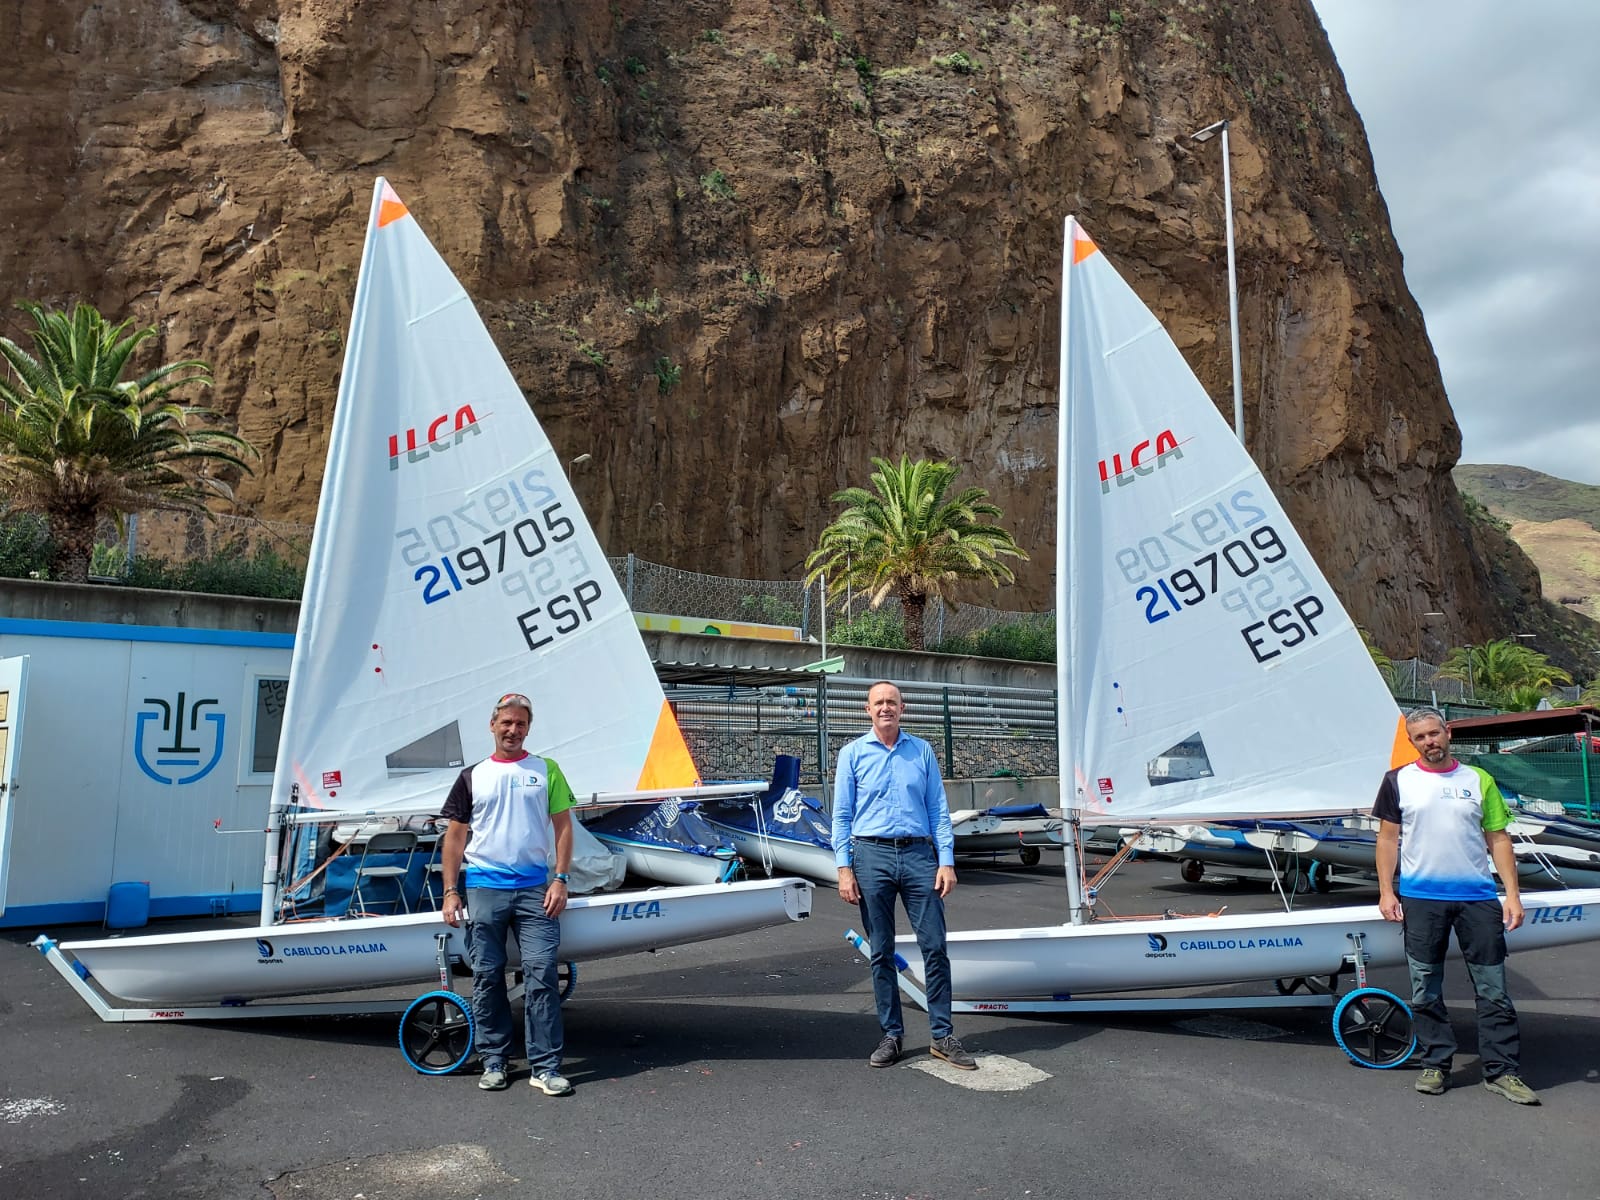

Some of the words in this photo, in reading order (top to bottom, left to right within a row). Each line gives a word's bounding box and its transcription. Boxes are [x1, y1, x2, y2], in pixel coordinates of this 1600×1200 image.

[389, 404, 482, 470] ILCA
[1098, 430, 1184, 494] ILCA
[414, 503, 575, 604] 219705
[1136, 525, 1287, 623] 219709
[517, 580, 601, 651] ESP
[1241, 595, 1324, 663] ESP
[611, 900, 661, 921] ILCA
[1531, 905, 1583, 924] ILCA
[283, 946, 331, 957] CABILDO
[333, 945, 347, 955] LA
[349, 943, 388, 954] PALMA
[1145, 951, 1177, 959] deportes
[1180, 940, 1236, 950] CABILDO
[1239, 939, 1255, 949] LA
[1258, 937, 1304, 948] PALMA
